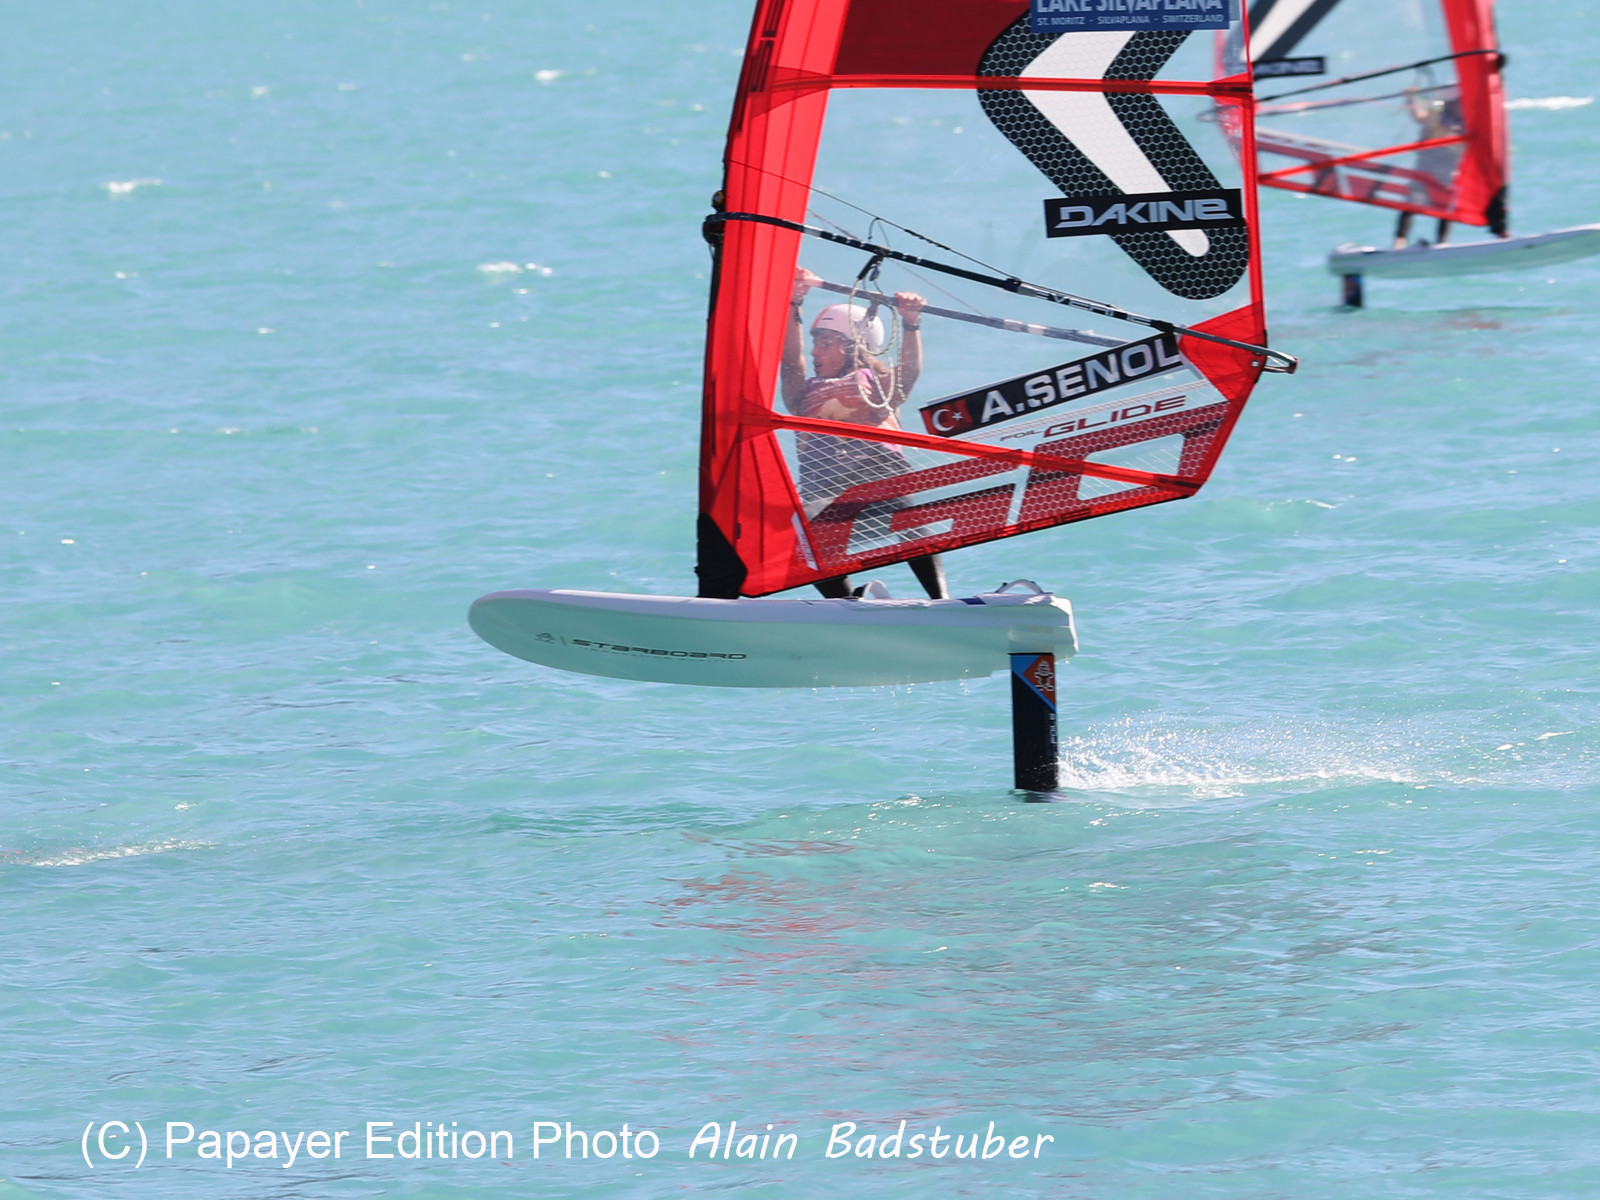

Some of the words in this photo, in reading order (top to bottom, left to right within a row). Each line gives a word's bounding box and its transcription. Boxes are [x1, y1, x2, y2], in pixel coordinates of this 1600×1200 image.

[1051, 16, 1086, 26] MORITZ
[1097, 15, 1150, 25] SILVAPLANA
[1162, 14, 1225, 24] SWITZERLAND
[1054, 198, 1235, 229] DAKINE
[1000, 429, 1044, 442] FOIL
[1043, 394, 1187, 439] GLIDE
